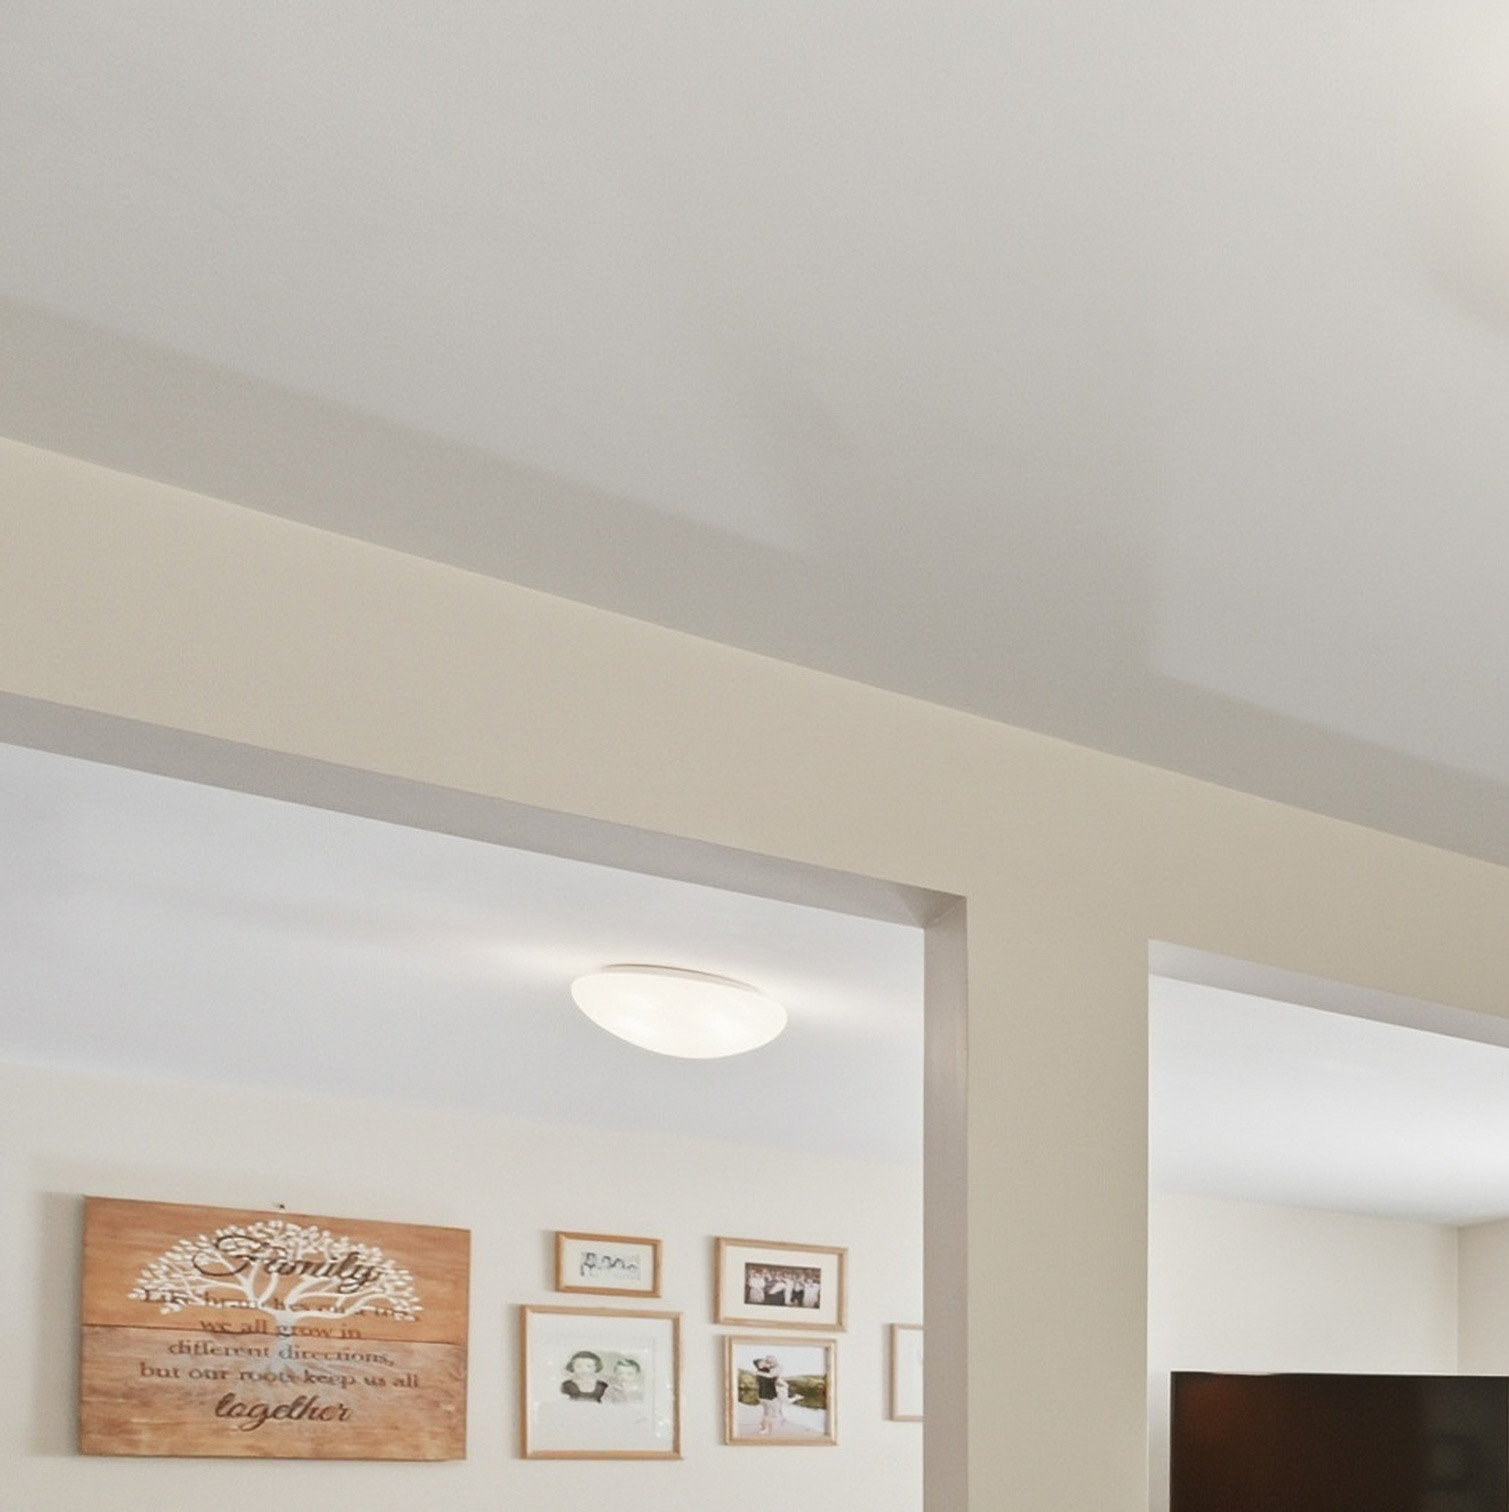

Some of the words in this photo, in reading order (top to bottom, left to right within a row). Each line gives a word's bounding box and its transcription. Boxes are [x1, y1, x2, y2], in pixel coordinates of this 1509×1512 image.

[192, 1236, 381, 1293] Family
[200, 1320, 231, 1332] we
[239, 1319, 268, 1334] all
[277, 1322, 333, 1338] grow
[340, 1324, 362, 1338] in
[168, 1340, 270, 1358] different
[278, 1344, 395, 1366] directions,
[140, 1362, 180, 1379] but
[189, 1367, 229, 1380] our
[240, 1369, 295, 1384] roots
[302, 1370, 357, 1388] keep
[364, 1376, 386, 1387] us
[392, 1373, 418, 1388] all
[215, 1392, 351, 1430] together
